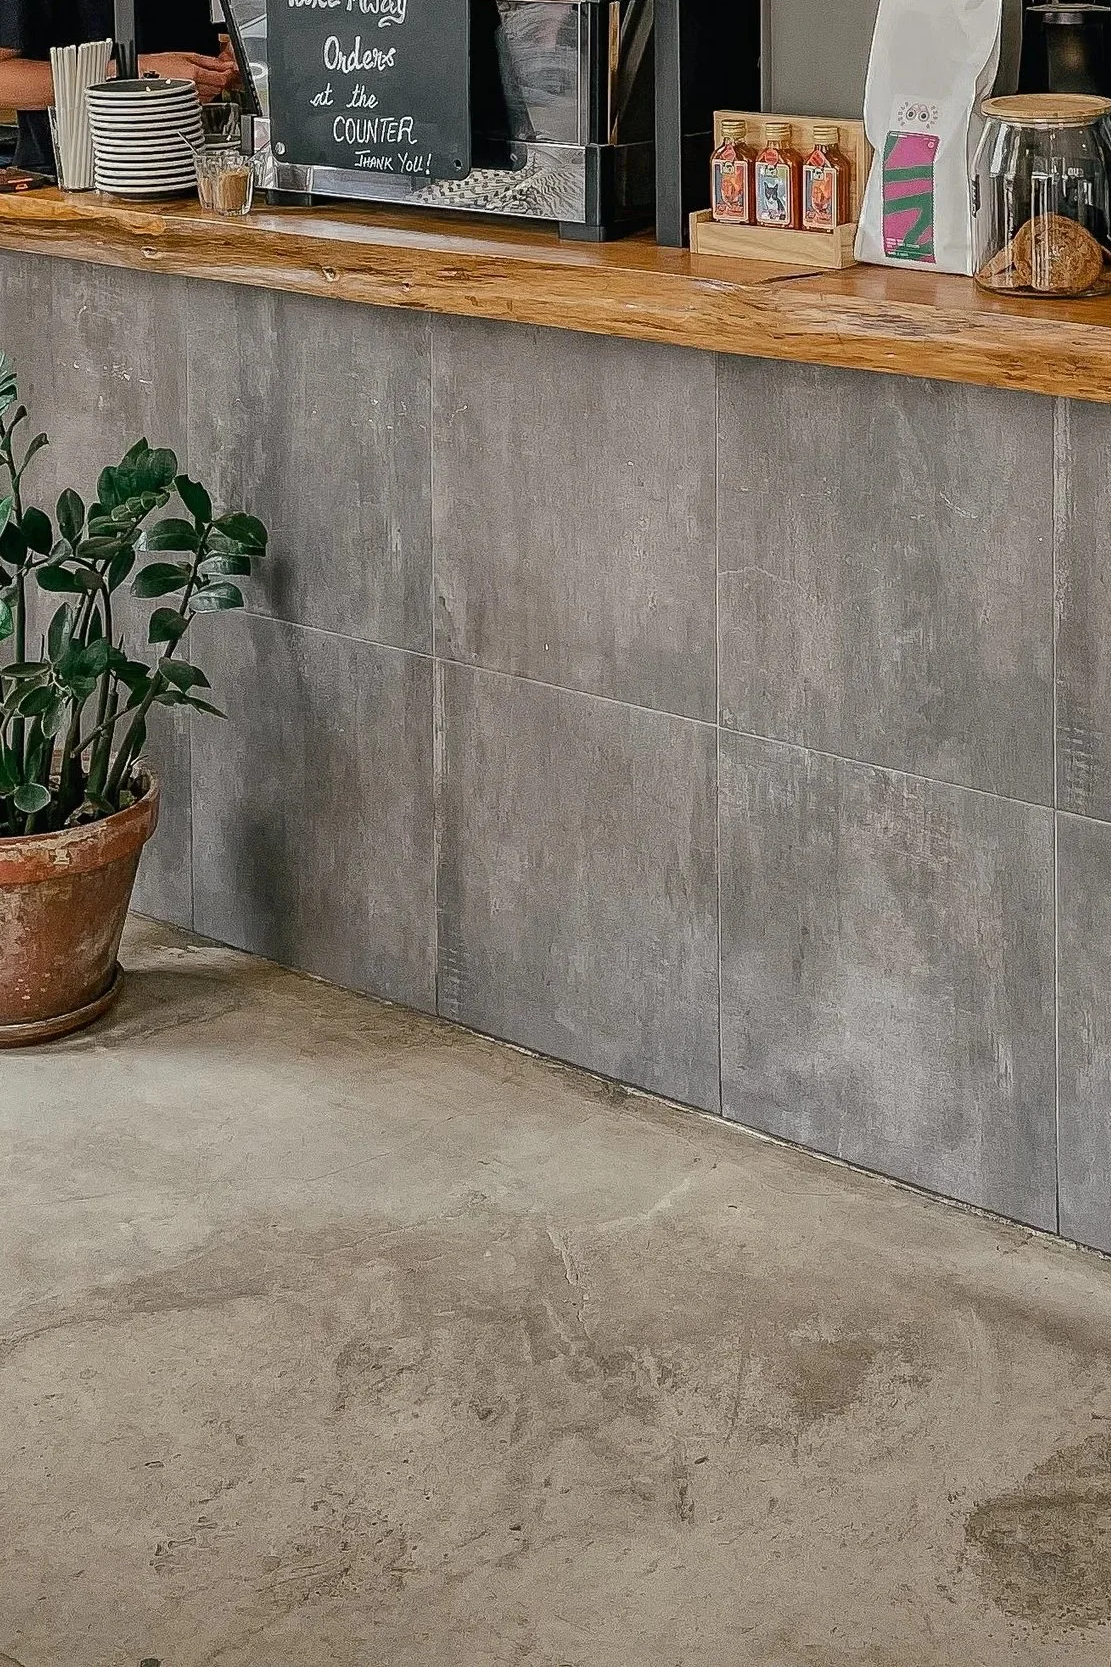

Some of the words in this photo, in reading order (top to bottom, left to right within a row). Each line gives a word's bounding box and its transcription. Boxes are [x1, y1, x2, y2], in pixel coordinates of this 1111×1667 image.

[324, 35, 397, 74] Orders
[310, 82, 334, 106] at
[346, 83, 379, 109] the
[333, 115, 418, 145] COUNTER
[354, 150, 394, 171] THANK
